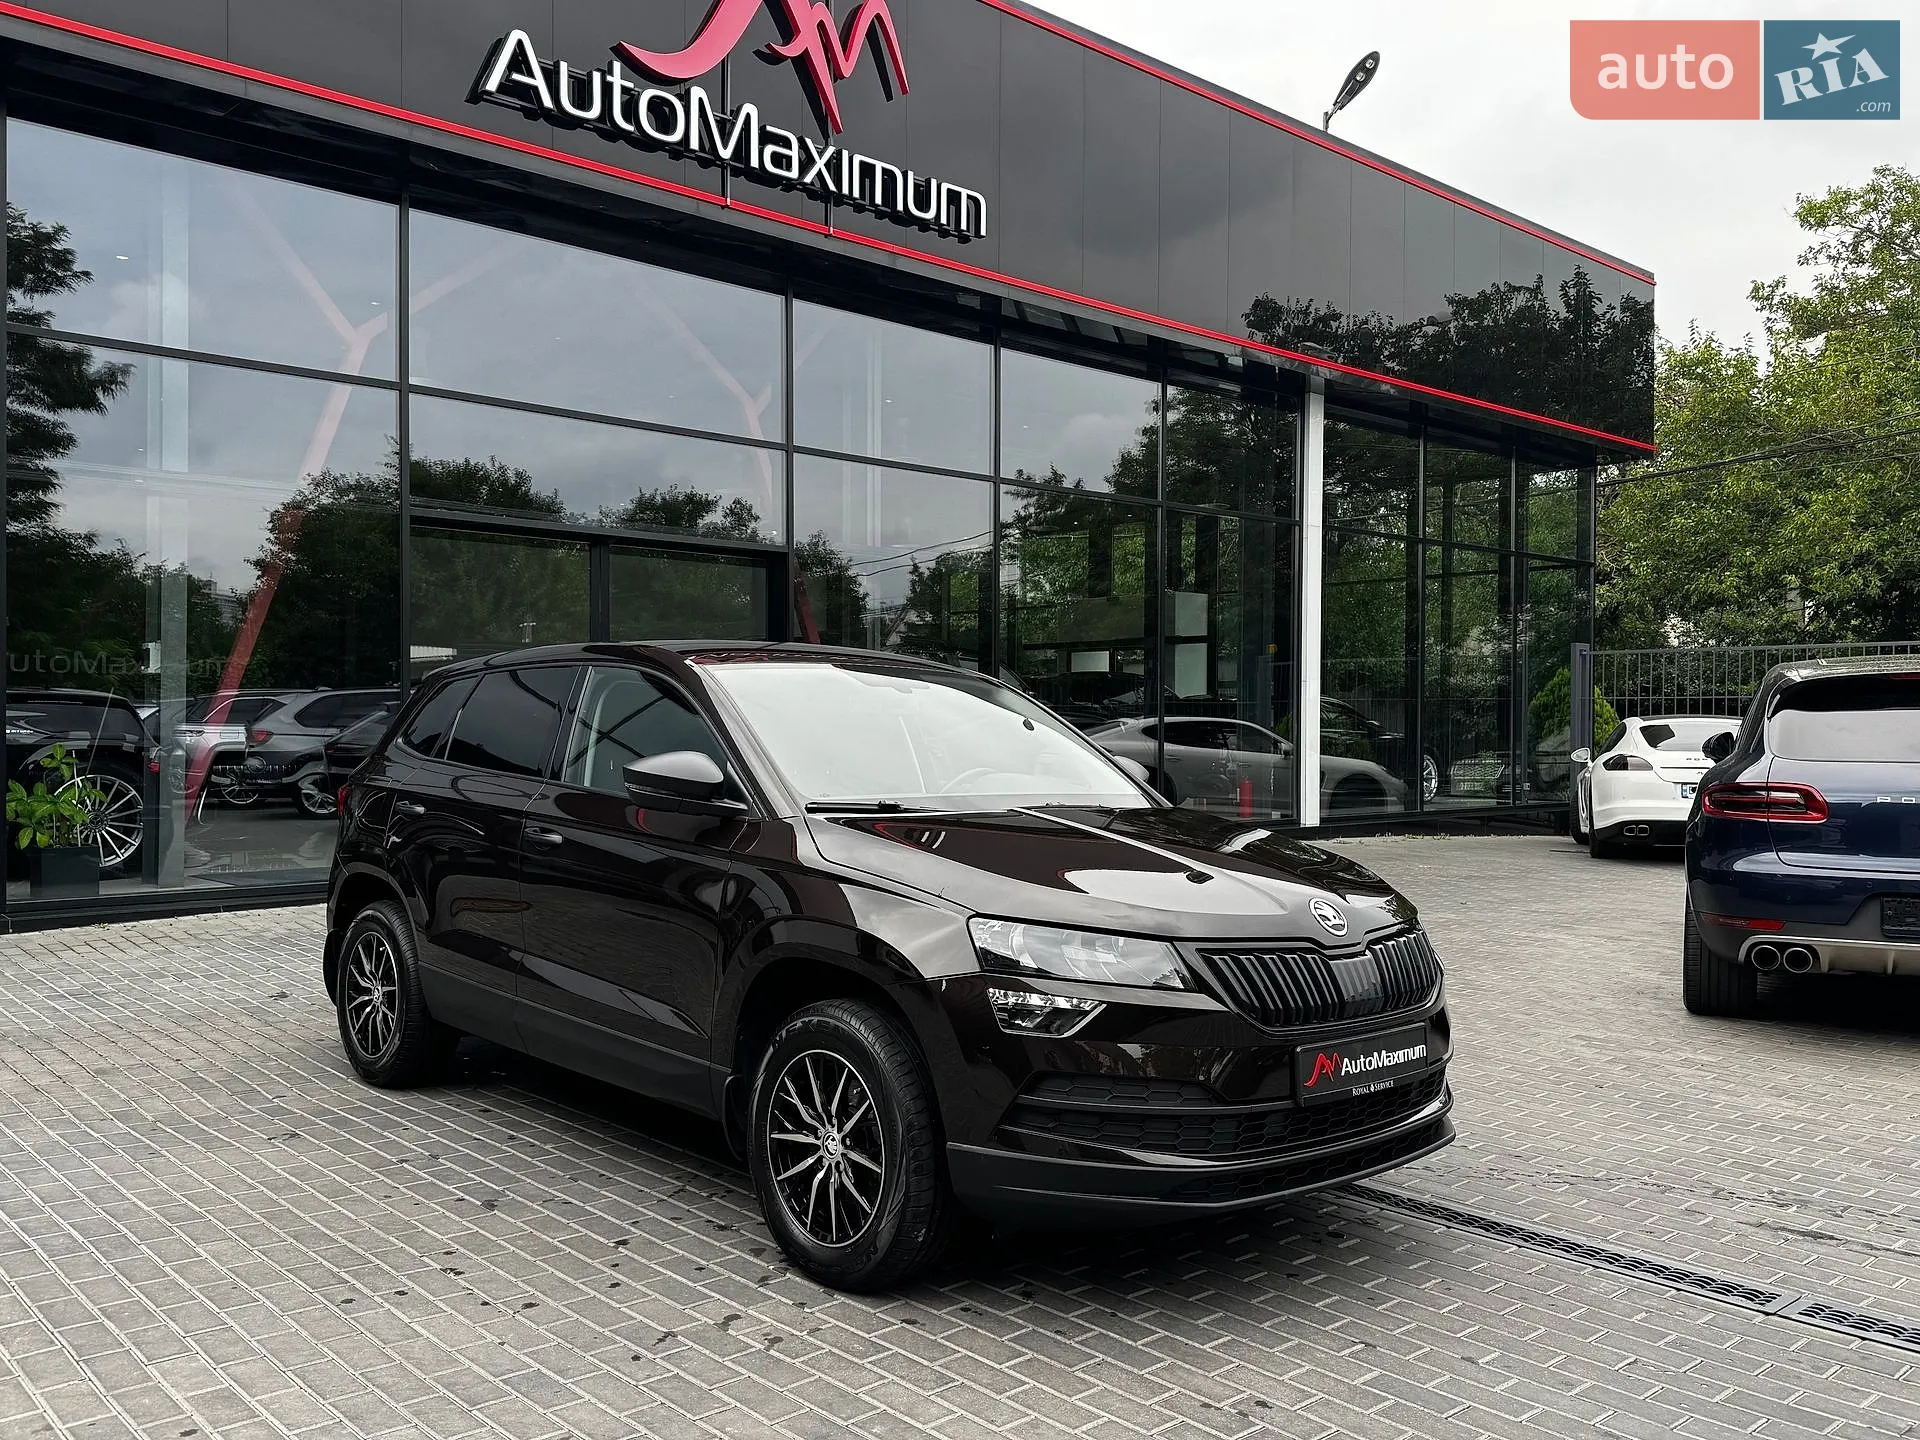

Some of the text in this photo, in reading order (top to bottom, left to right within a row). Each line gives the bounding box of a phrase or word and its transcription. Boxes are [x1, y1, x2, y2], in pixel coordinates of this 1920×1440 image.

[484, 28, 988, 239] AutoMaximum
[1341, 1044, 1427, 1077] AutoMaximum
[1374, 1080, 1394, 1092] SERVICE
